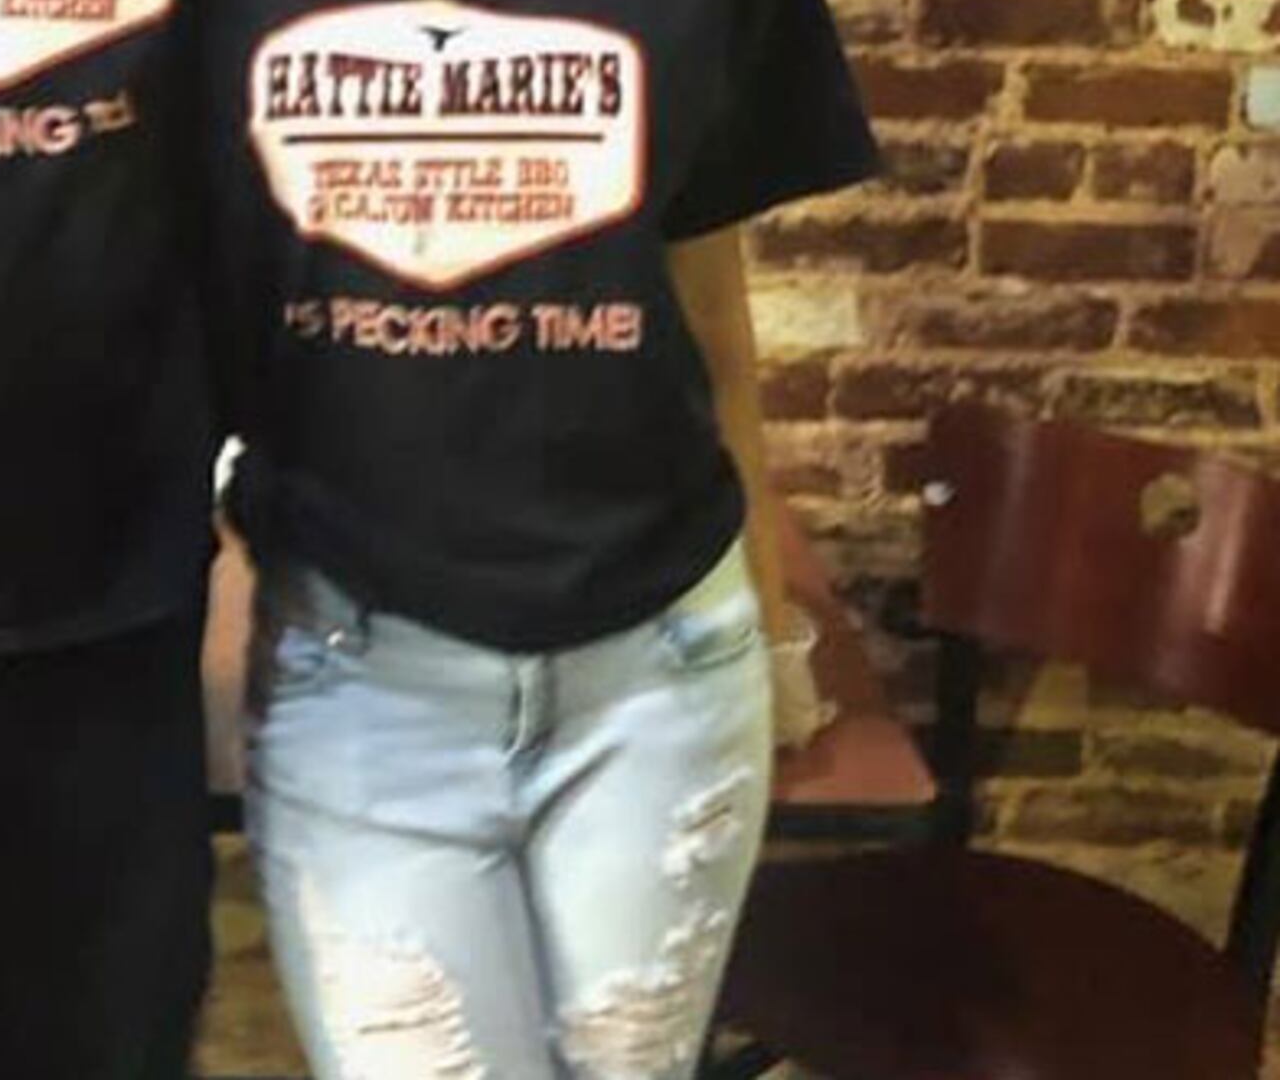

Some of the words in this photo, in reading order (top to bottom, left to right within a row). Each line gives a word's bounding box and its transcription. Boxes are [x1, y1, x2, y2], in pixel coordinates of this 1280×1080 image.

[265, 51, 423, 119] HATTIE
[439, 51, 623, 119] MARIE'S
[309, 158, 402, 188] TEXAS
[412, 157, 502, 188] STYLE
[517, 156, 570, 187] BBQ
[333, 191, 433, 225] CAJUN
[445, 192, 574, 224] KITCHEN
[329, 296, 523, 356] PECKING
